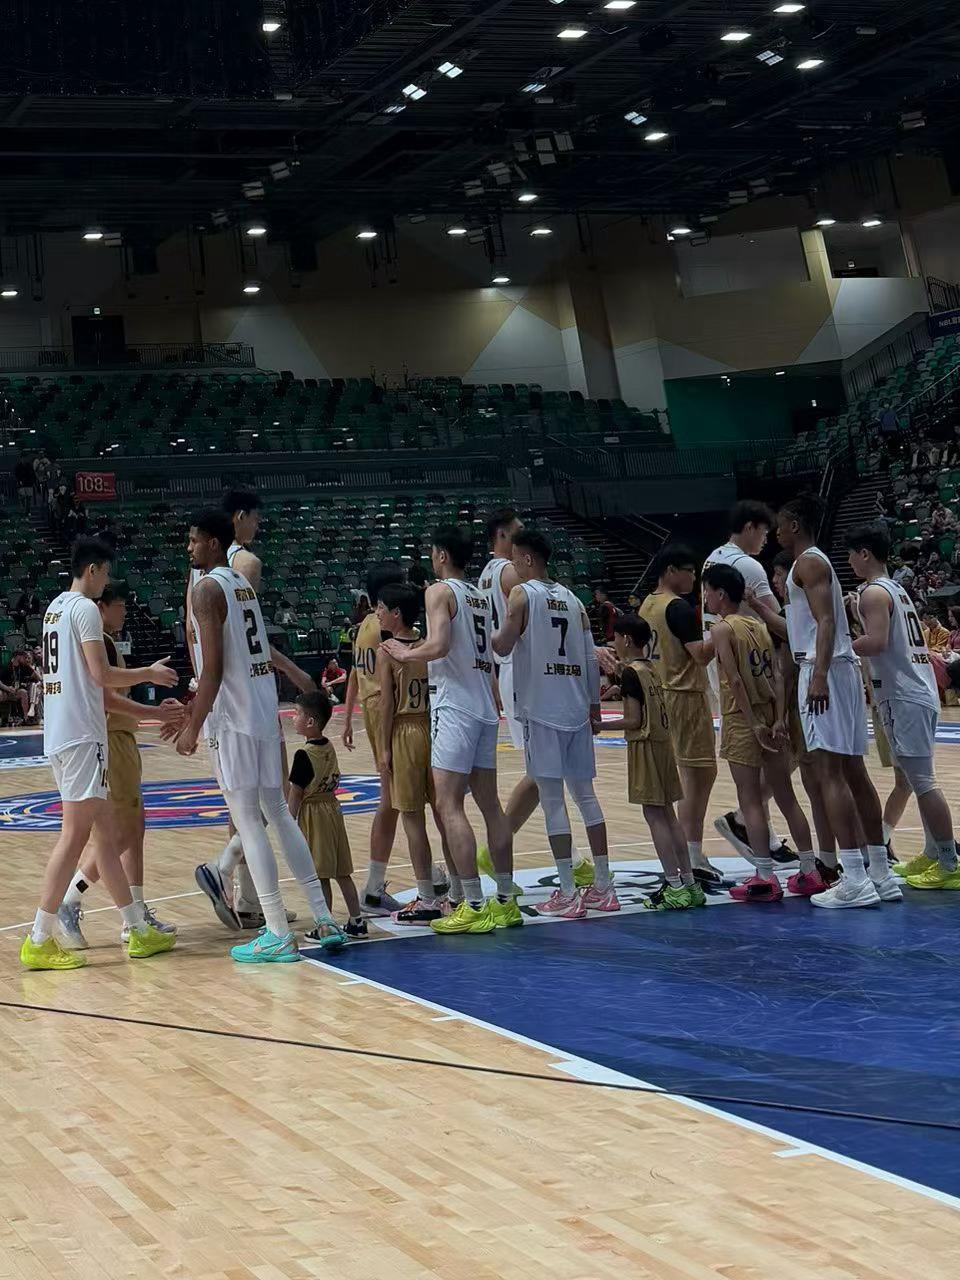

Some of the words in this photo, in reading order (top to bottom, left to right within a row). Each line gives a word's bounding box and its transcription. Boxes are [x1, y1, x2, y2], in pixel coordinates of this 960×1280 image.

[78, 477, 103, 492] 108
[243, 608, 263, 656] 2
[473, 614, 487, 654] 5
[551, 616, 569, 657] 7
[905, 611, 925, 647] 10
[43, 630, 59, 674] 19
